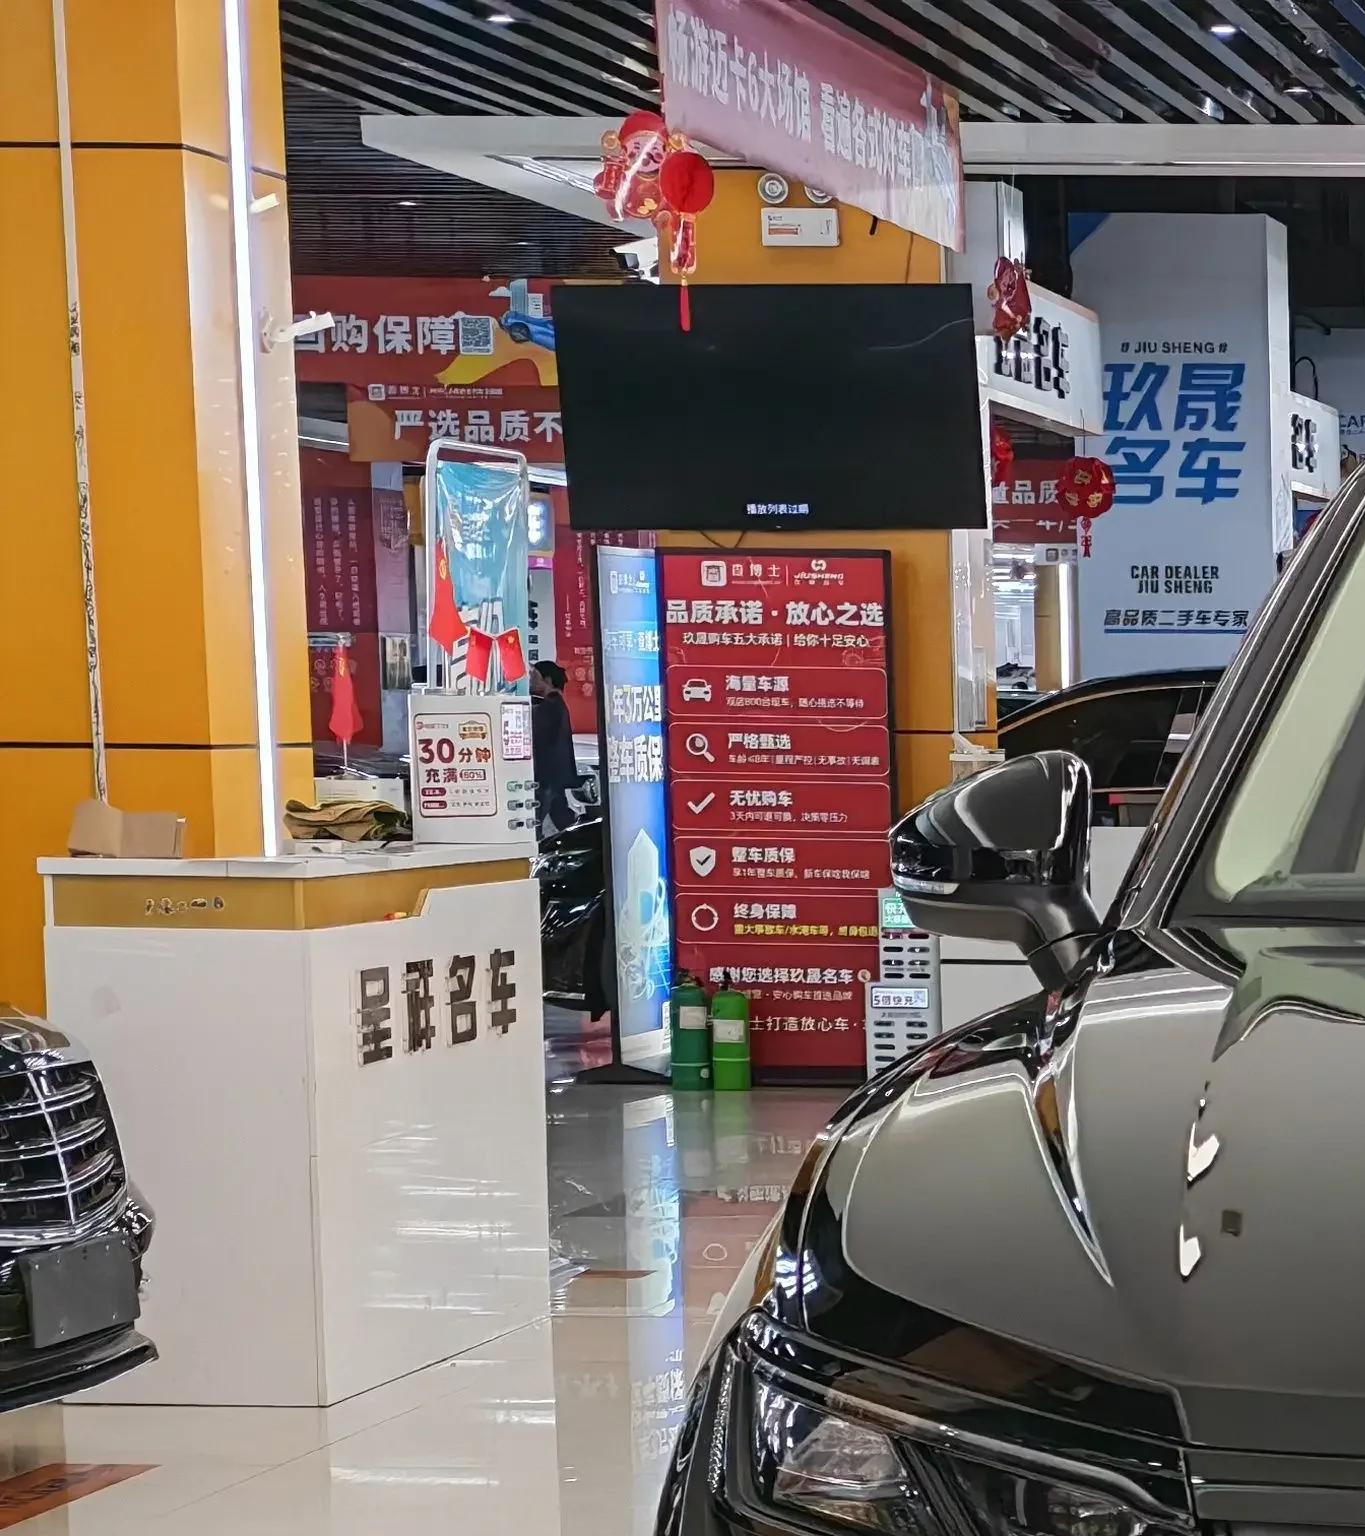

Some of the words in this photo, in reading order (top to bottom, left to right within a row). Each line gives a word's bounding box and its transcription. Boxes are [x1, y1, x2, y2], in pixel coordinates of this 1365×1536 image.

[1133, 341, 1157, 354] JIU
[1162, 341, 1216, 354] SHENG
[1102, 362, 1246, 432] 玖晟
[1104, 437, 1247, 505] 名车
[1130, 565, 1160, 580] CAR
[1164, 565, 1220, 580] DEALER
[1136, 580, 1160, 595] JIU
[1163, 580, 1214, 595] SHENG
[665, 599, 885, 627] 品质承诺·放心之选
[1103, 609, 1250, 627] 高品质二手车专家
[724, 674, 790, 692] 海量车源
